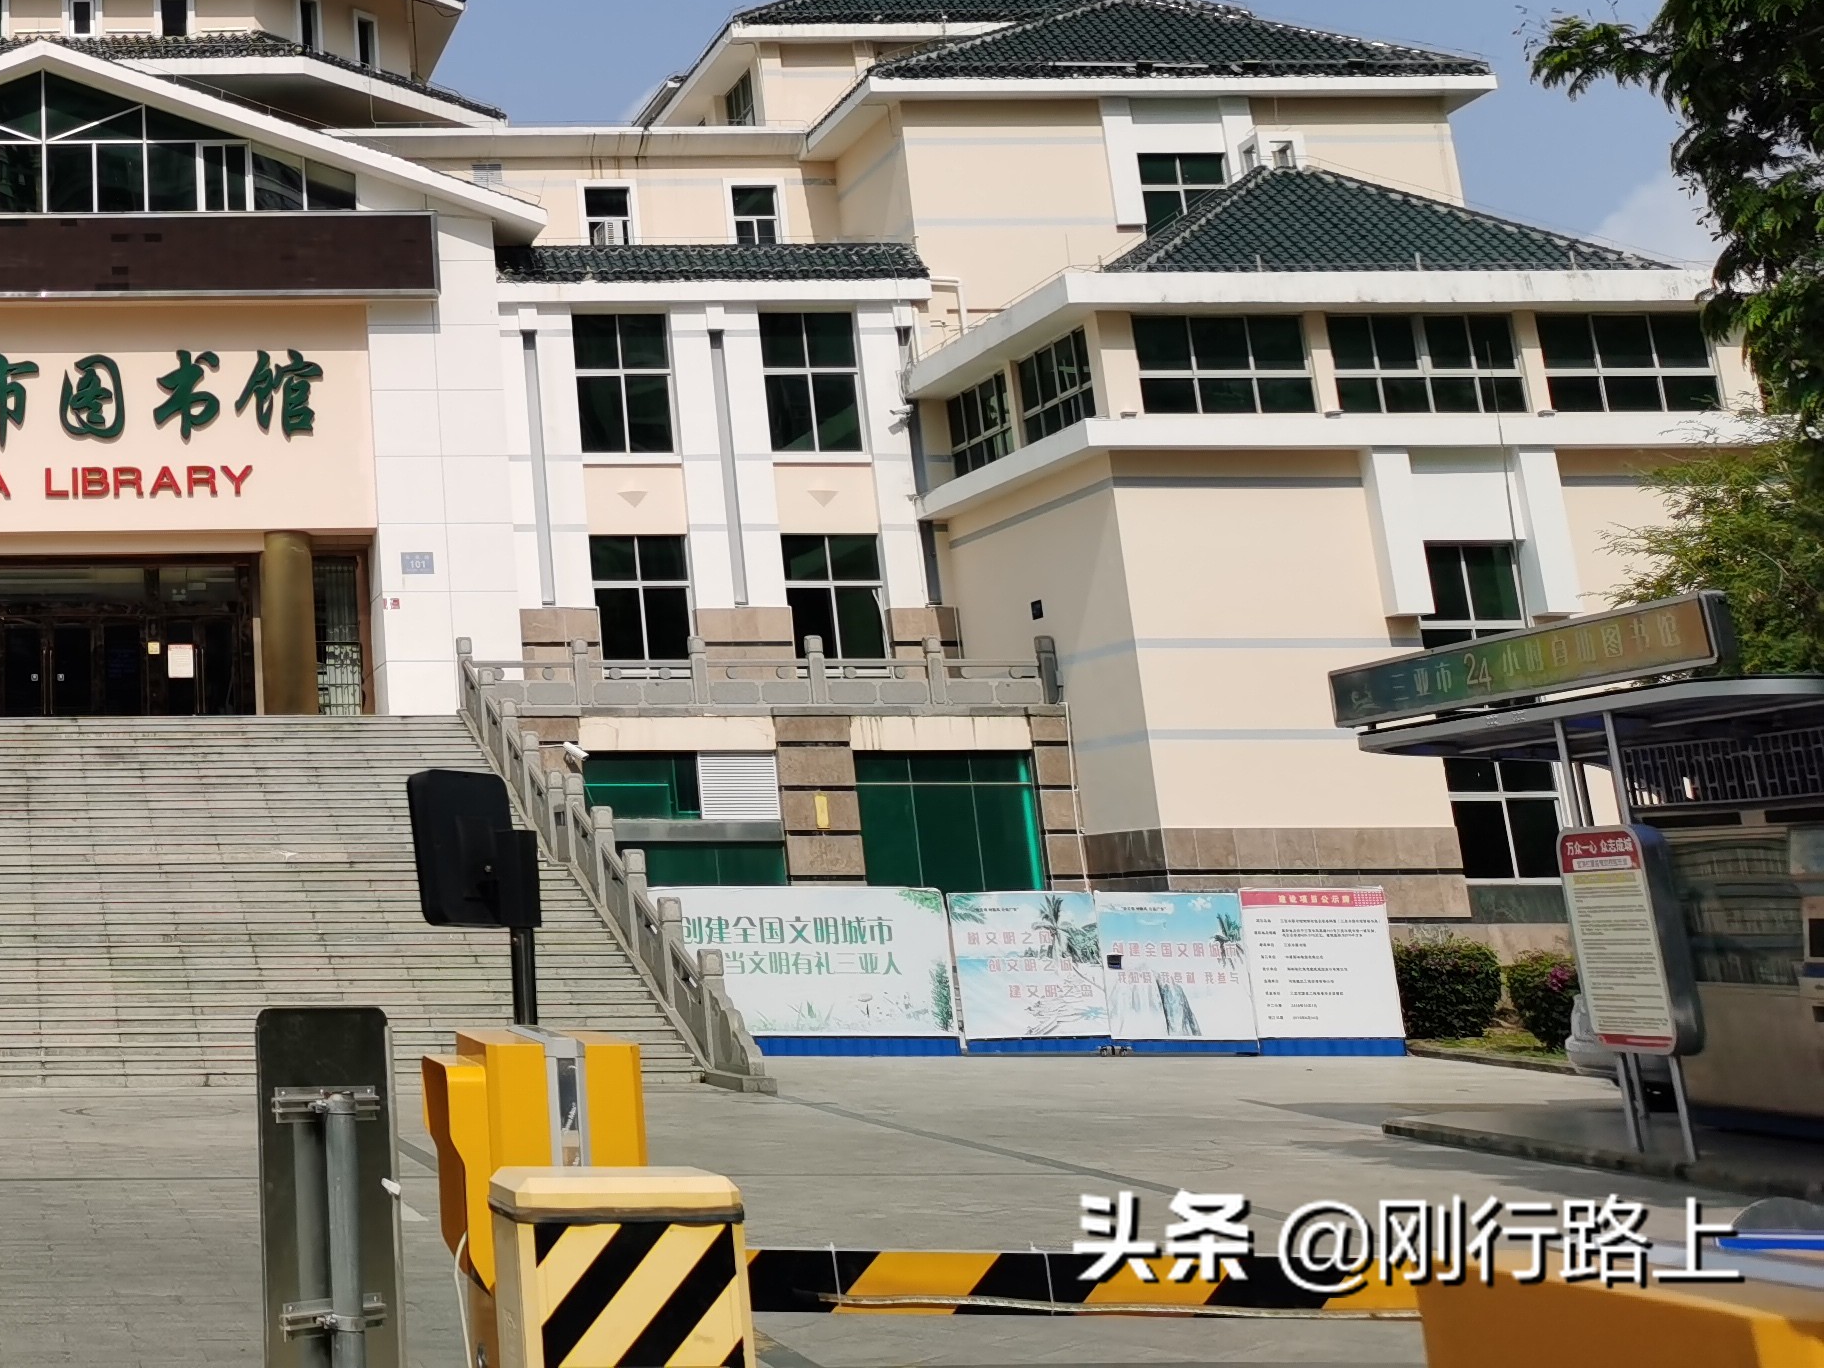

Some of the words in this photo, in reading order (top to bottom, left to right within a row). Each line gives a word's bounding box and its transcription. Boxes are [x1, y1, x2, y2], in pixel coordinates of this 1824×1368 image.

[45, 465, 253, 499] LIBRARY
[410, 560, 426, 569] 101
[1565, 840, 1597, 856] 万众一心
[1599, 836, 1634, 853] 众志成城
[681, 915, 894, 946] 创建全国文明城市
